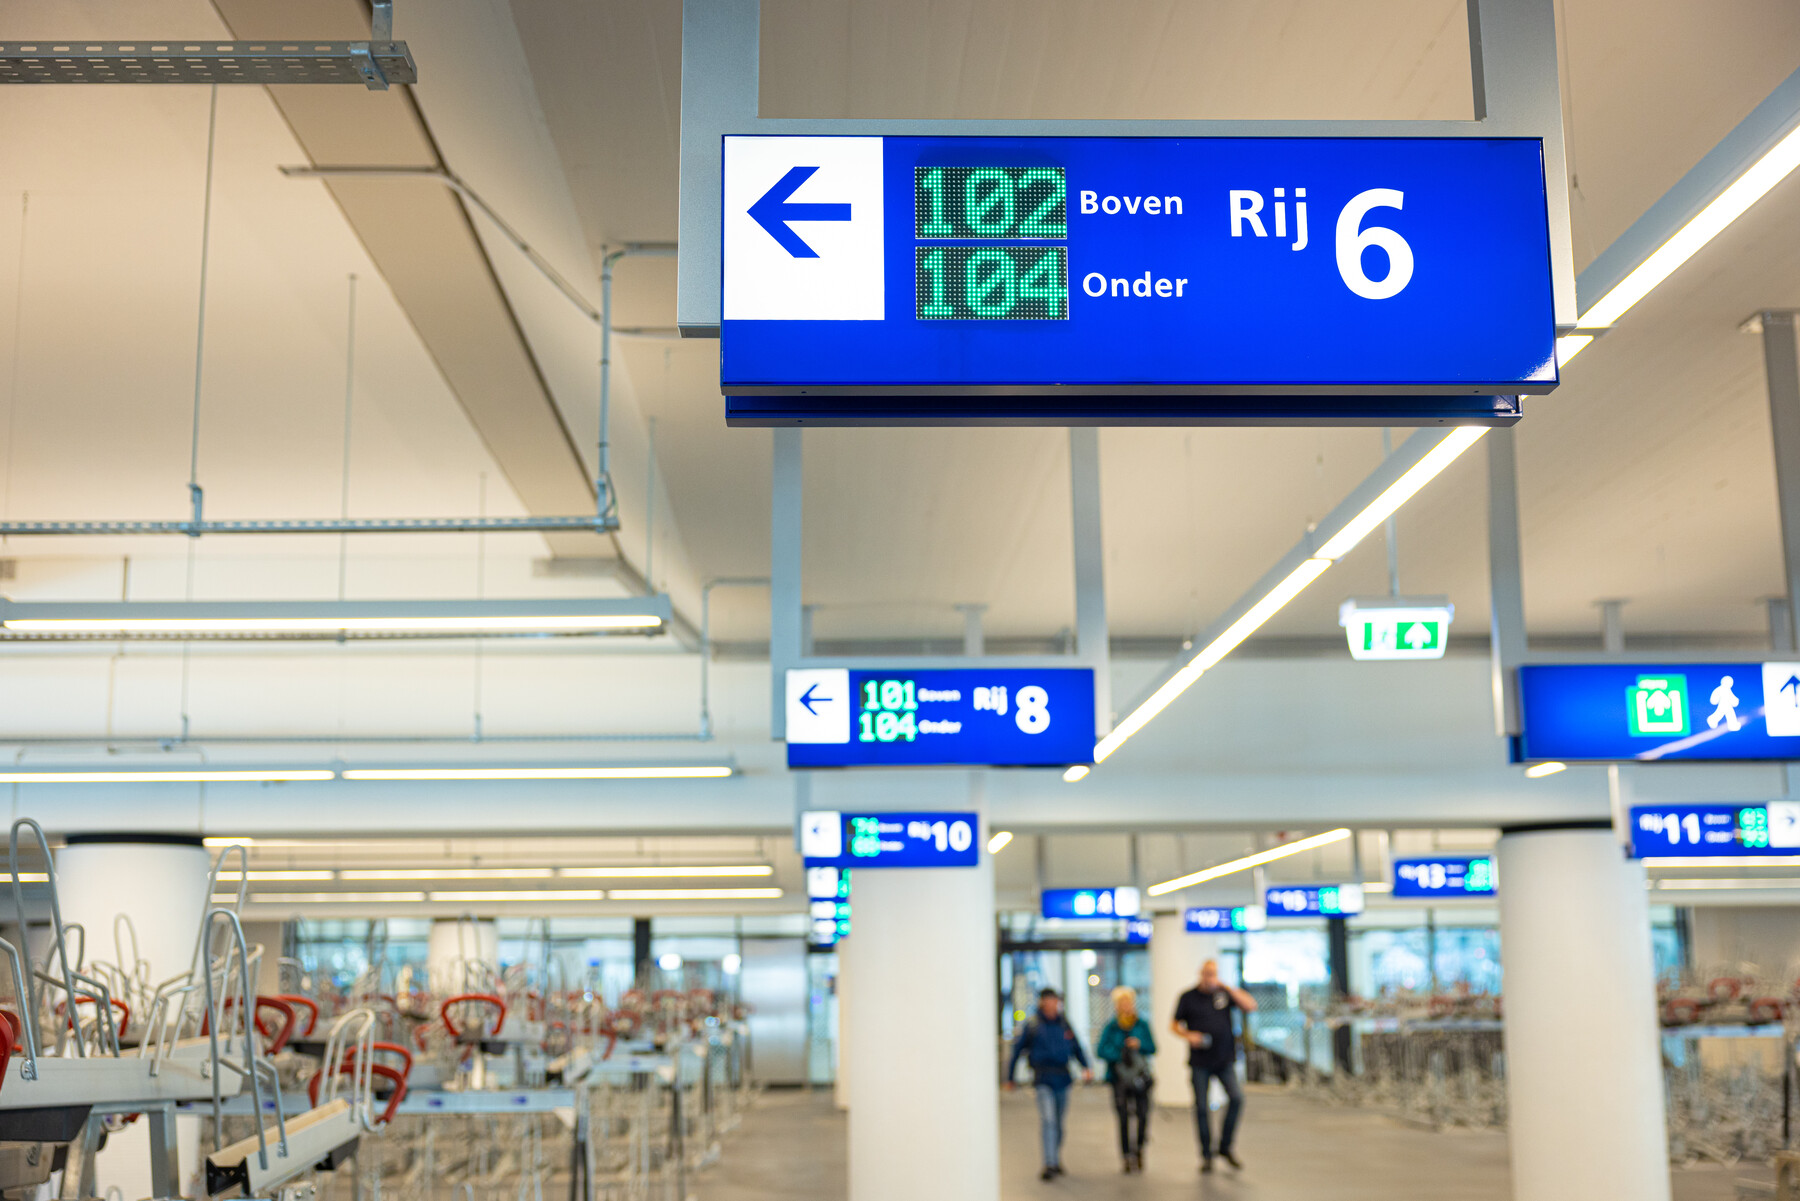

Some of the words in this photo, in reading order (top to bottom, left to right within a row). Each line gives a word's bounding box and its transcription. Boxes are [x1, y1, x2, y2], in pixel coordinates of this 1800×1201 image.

[921, 168, 1067, 236] 102
[1080, 190, 1183, 215] Boven
[1229, 187, 1308, 252] Rij
[1335, 187, 1415, 300] 6
[922, 249, 1068, 317] 104
[1082, 272, 1188, 298] Onder
[863, 679, 919, 711] 101
[973, 686, 1008, 716] Rij
[1014, 685, 1051, 735] 8
[858, 711, 919, 743] 104
[931, 820, 972, 852] 10
[1663, 813, 1700, 844] 11
